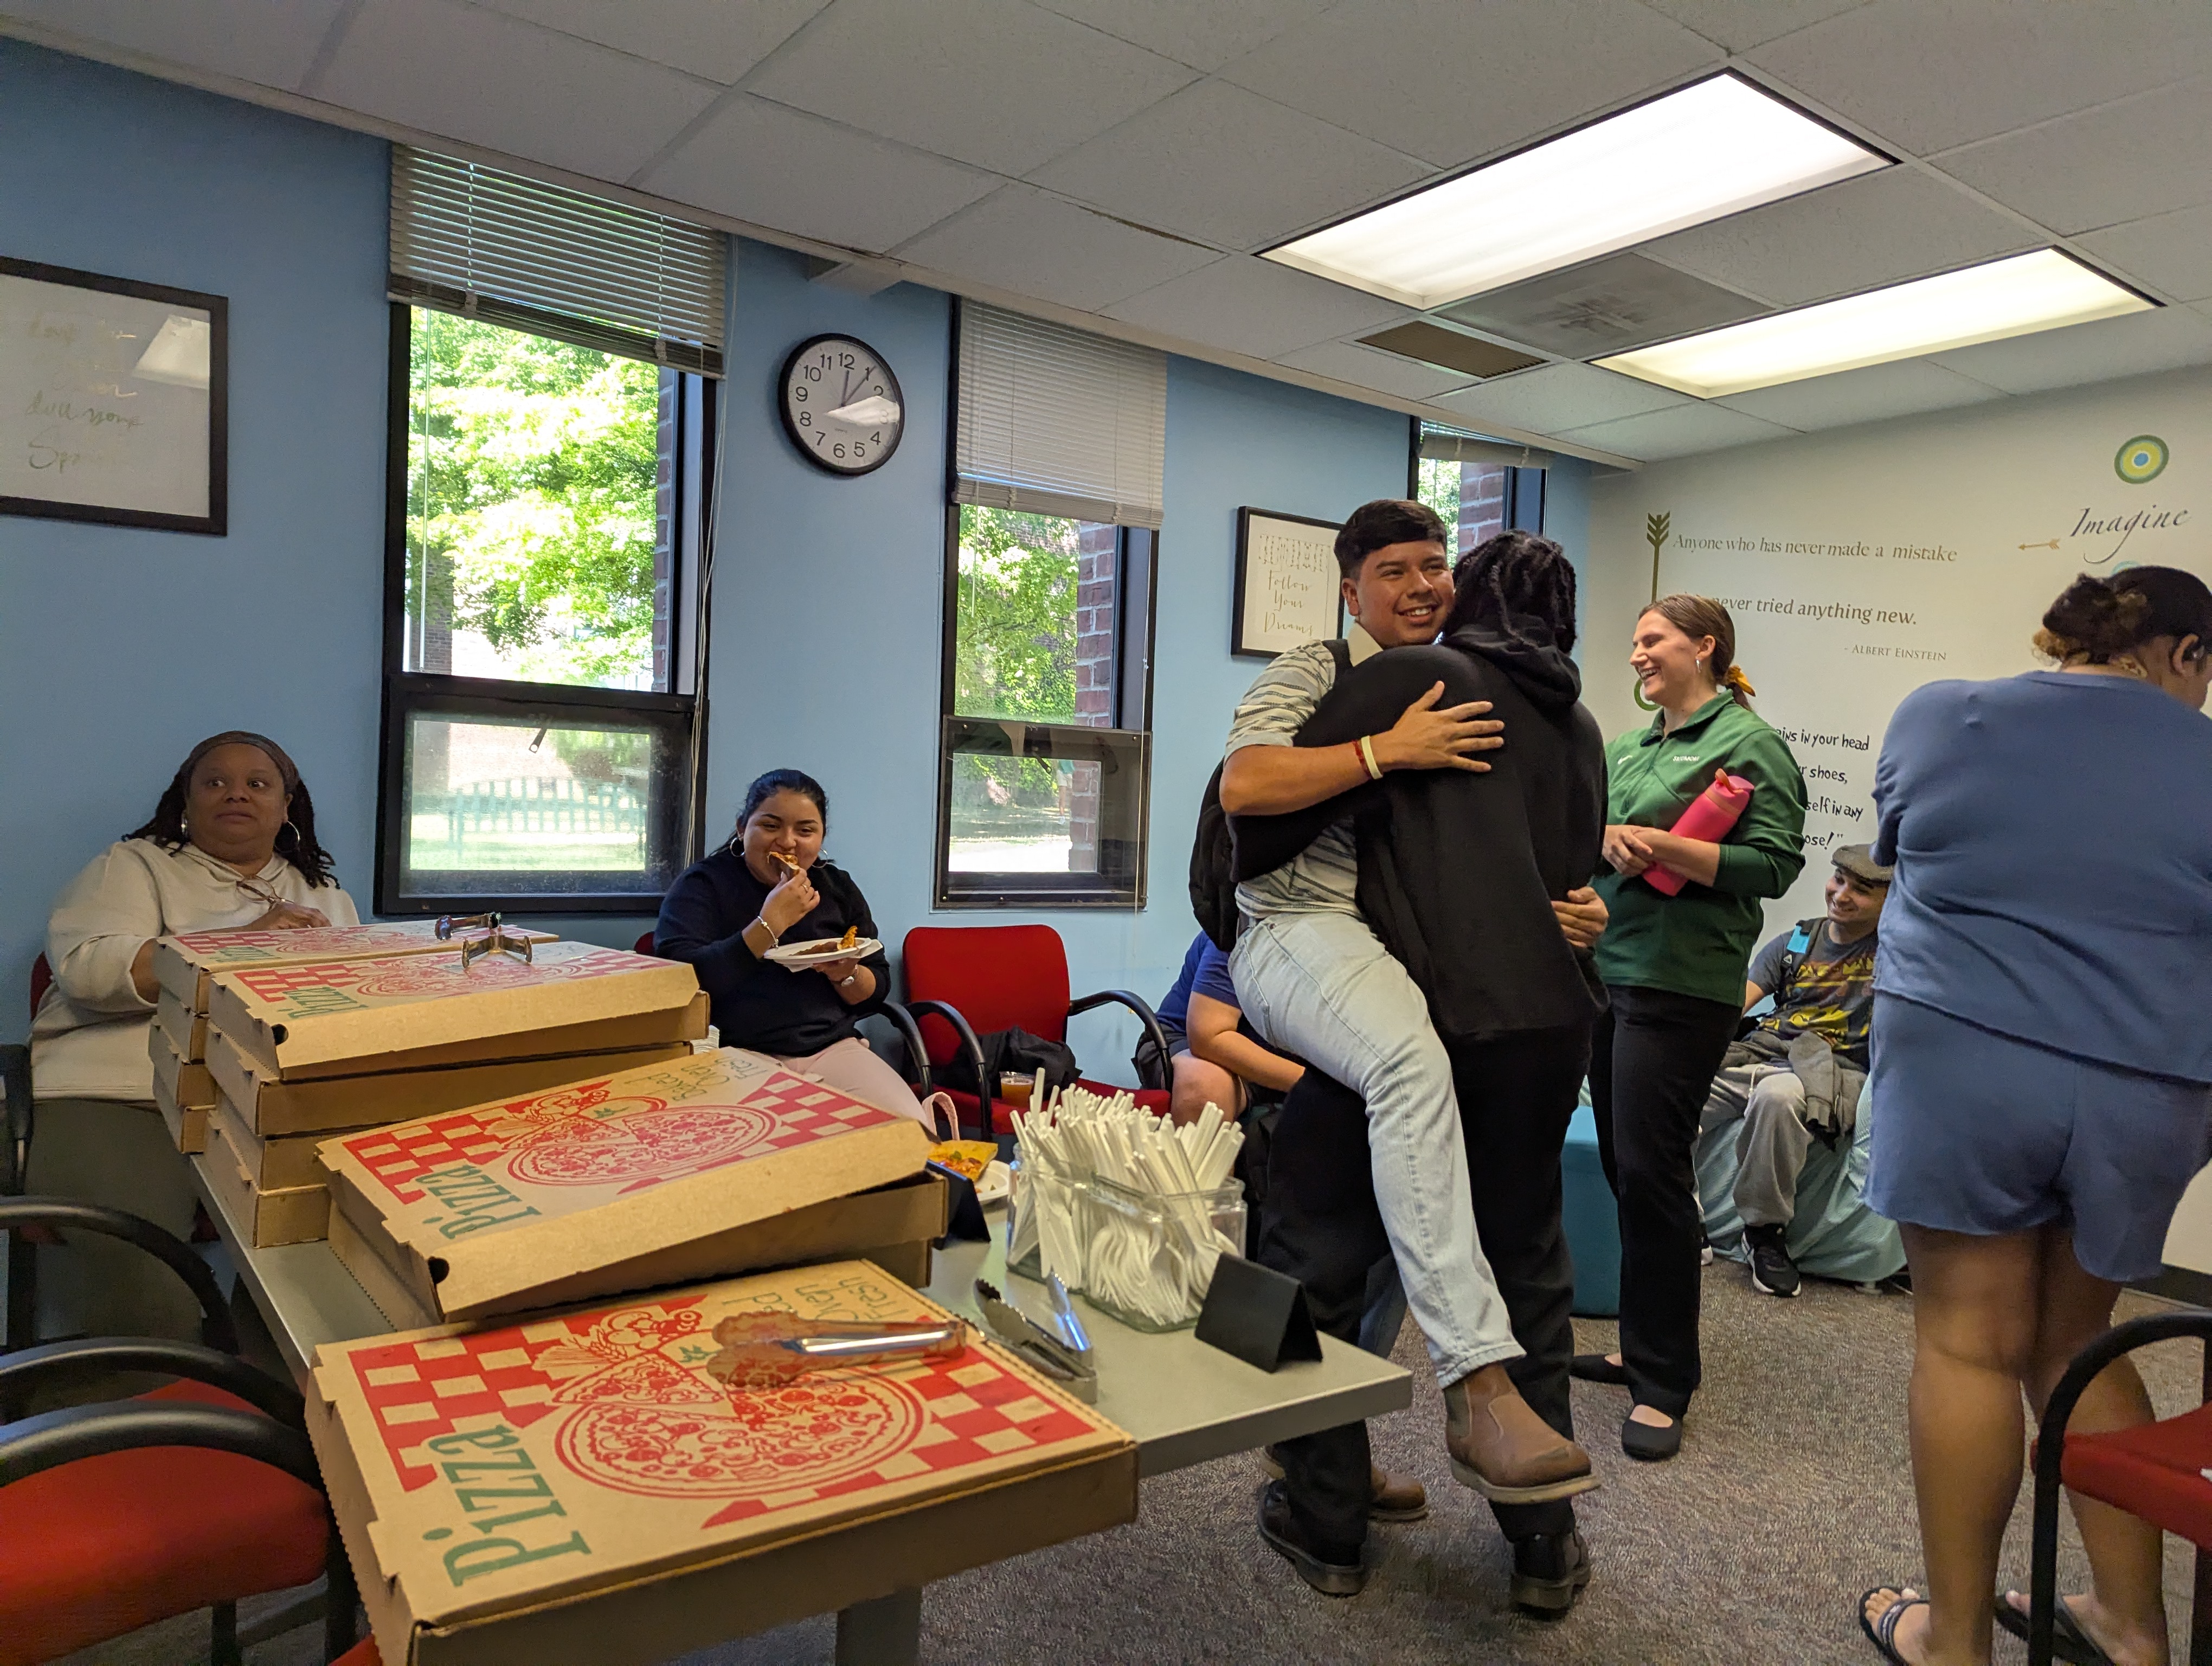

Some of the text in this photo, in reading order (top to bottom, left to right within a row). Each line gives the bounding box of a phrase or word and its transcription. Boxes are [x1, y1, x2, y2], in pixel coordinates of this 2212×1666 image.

[820, 354, 832, 370] 11
[839, 353, 855, 370] 12
[803, 365, 821, 382] 10
[865, 367, 869, 381] 1
[795, 387, 808, 402] 9
[800, 412, 811, 427] 8
[815, 431, 826, 446] 7
[870, 431, 881, 445] 4
[833, 443, 845, 458] 6
[853, 441, 865, 457] 5
[2069, 504, 2192, 563] Imagine
[1673, 535, 1958, 562] Anyone who has never made a mistake
[1269, 569, 1310, 591] Follow
[1274, 589, 1303, 612] Your
[1756, 598, 1793, 614] tried
[1797, 602, 1873, 625] anything
[1876, 610, 1917, 625] new.
[1264, 611, 1313, 636] Dreams
[1852, 644, 1892, 657] ALBERT
[1895, 648, 1946, 661] EINSTEIN
[1813, 734, 1840, 748] your
[1842, 734, 1870, 751] head
[1809, 765, 1848, 784] shoes,
[415, 1164, 542, 1240] Pizza
[422, 1424, 592, 1587] Pizza
